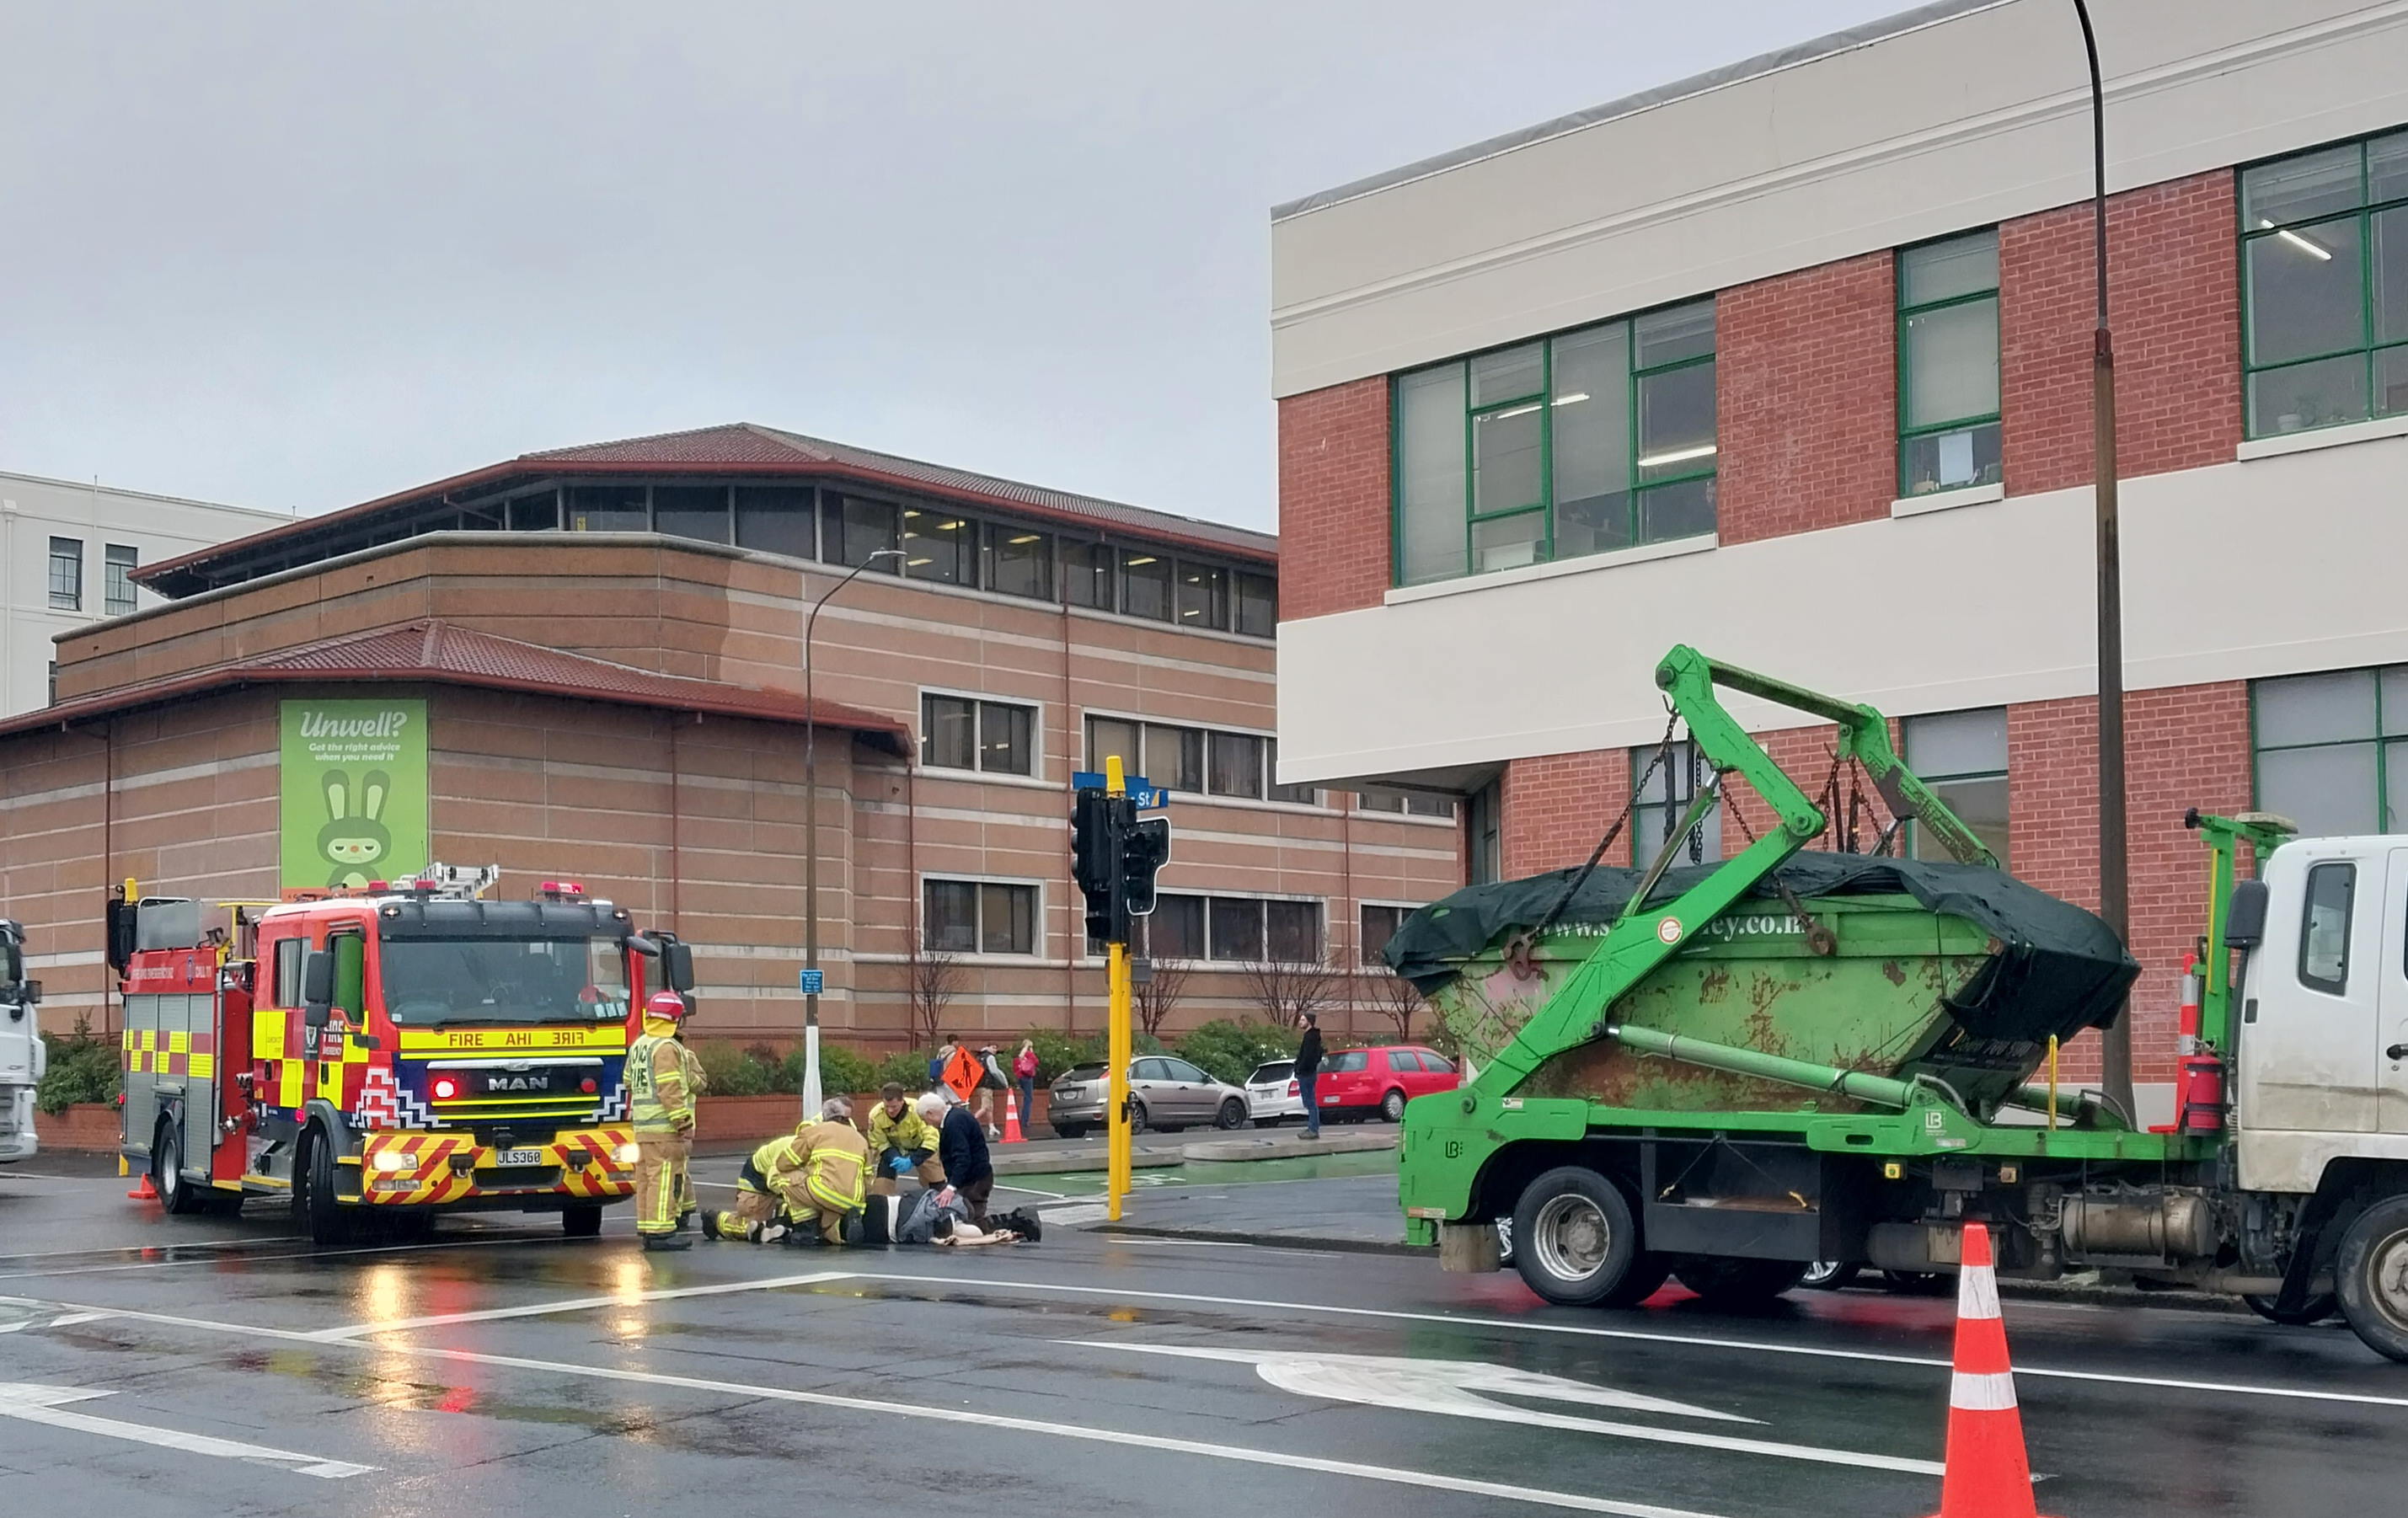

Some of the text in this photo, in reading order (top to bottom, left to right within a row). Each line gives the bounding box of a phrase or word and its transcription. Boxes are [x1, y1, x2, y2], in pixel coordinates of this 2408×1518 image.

[301, 712, 408, 737] Unwell?
[308, 742, 401, 752] Get the right advice
[315, 752, 394, 762] when you need it
[1138, 792, 1150, 806] St
[449, 1033, 484, 1046] FIRE
[506, 1033, 532, 1045] AHI
[488, 1077, 549, 1092] MAN
[498, 1152, 541, 1164] JLS360
